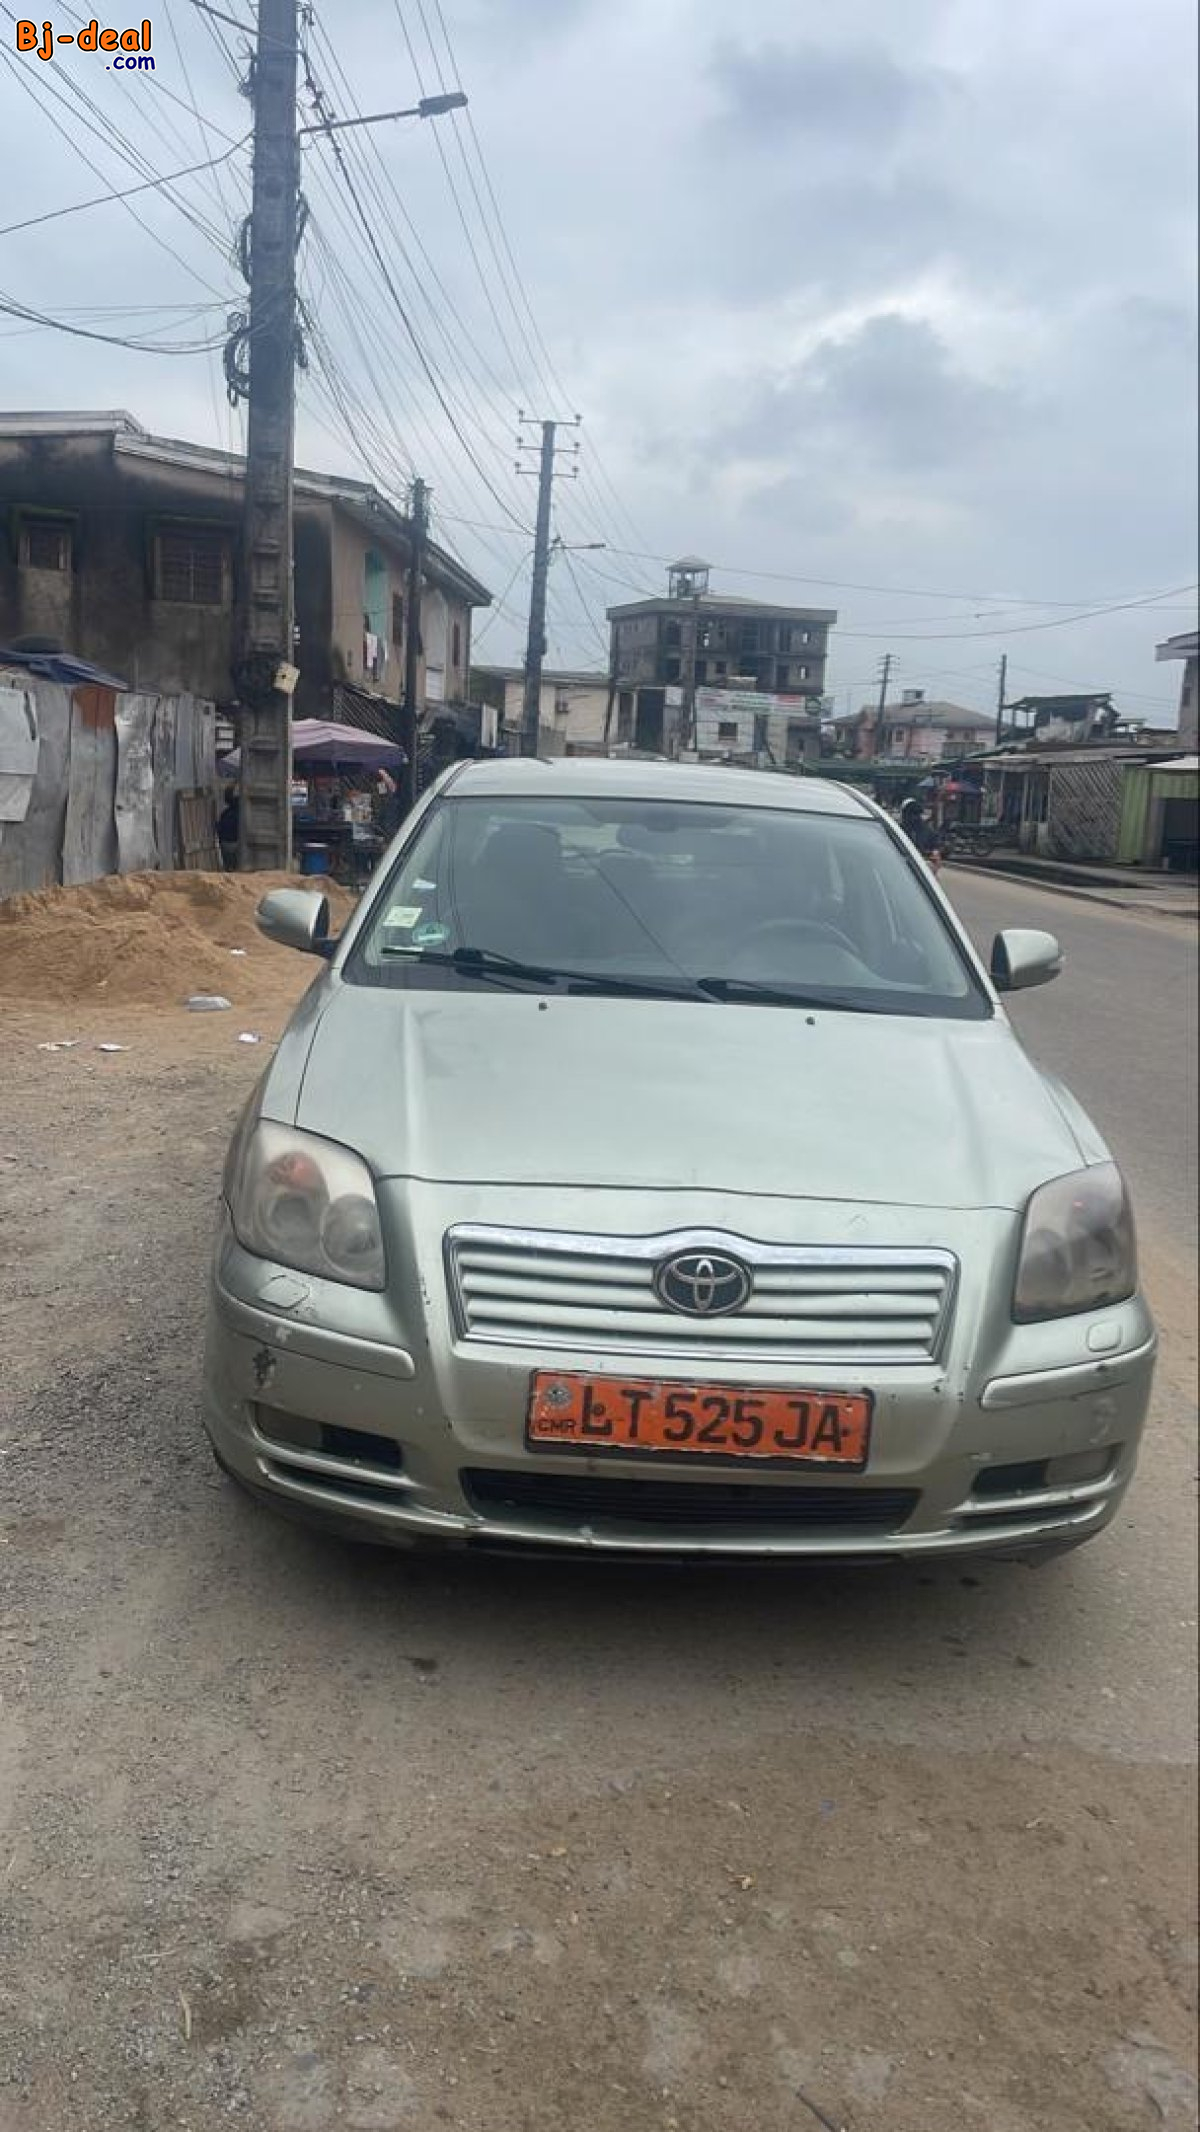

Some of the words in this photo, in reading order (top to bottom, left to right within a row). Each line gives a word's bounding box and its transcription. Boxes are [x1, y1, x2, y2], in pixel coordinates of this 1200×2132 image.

[537, 1418, 576, 1434] CMR
[663, 1393, 766, 1447] 525
[774, 1401, 842, 1452] JA
